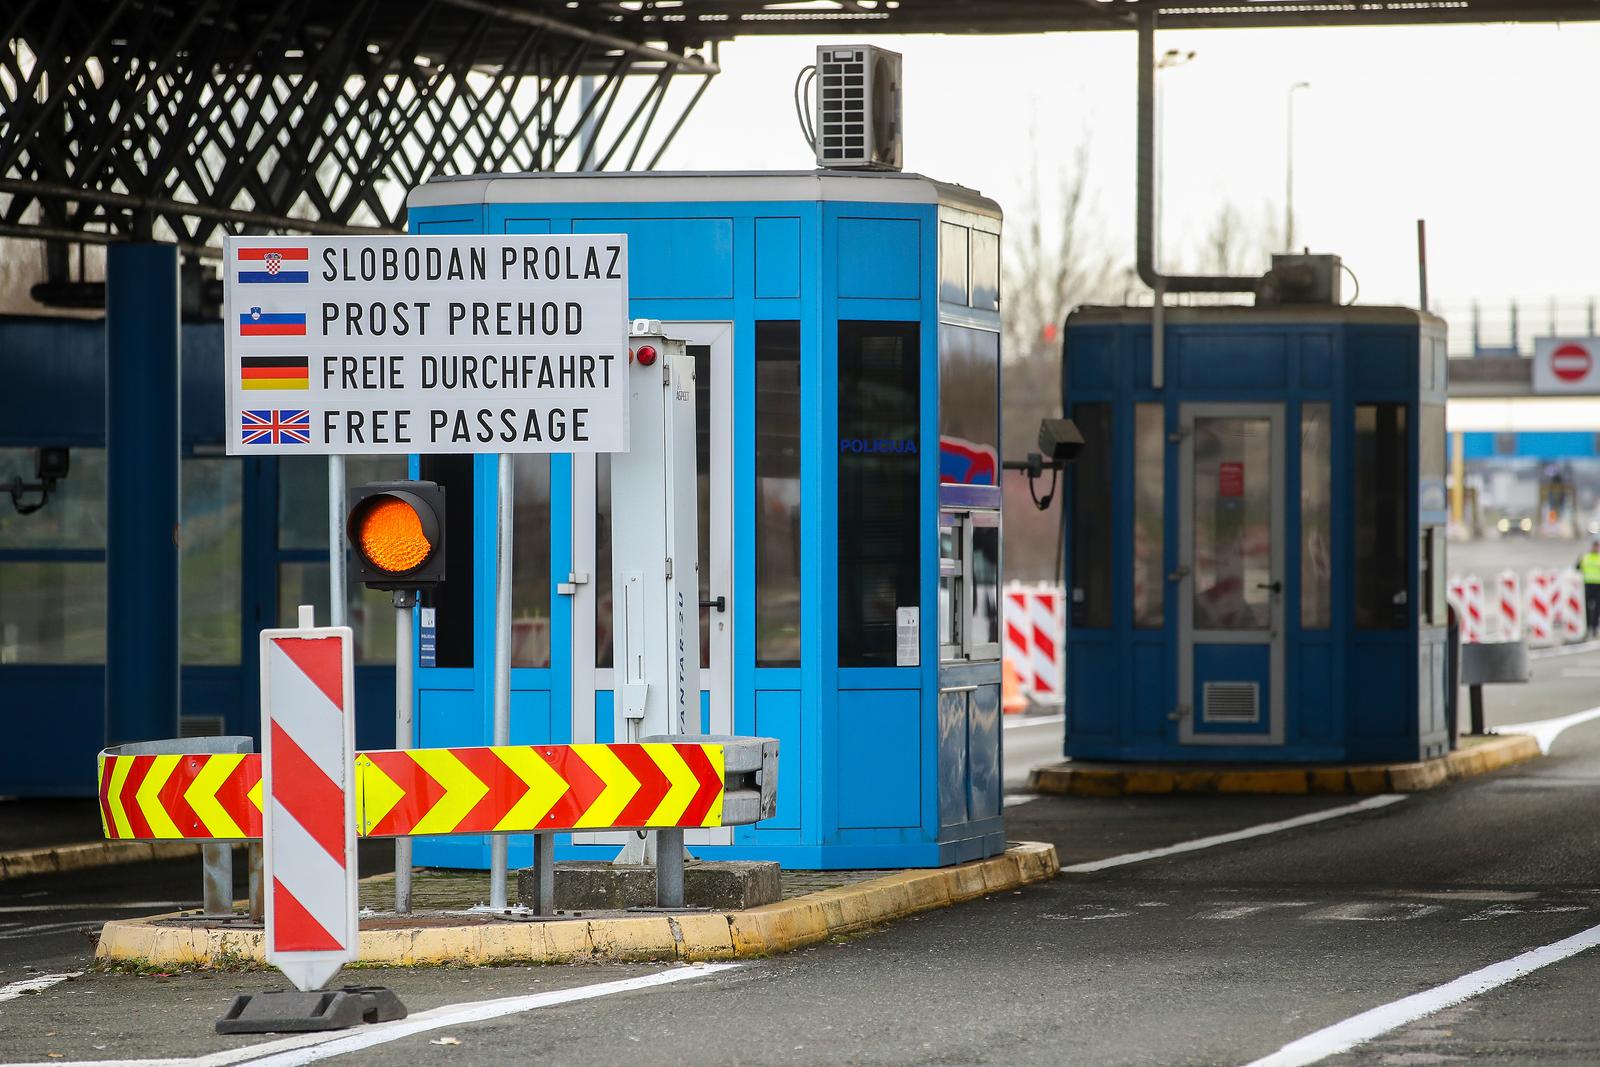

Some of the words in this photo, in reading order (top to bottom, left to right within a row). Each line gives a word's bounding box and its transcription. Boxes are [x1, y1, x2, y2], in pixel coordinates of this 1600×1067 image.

[322, 247, 486, 282] SLOBODAN
[501, 245, 622, 280] PROLAZ
[322, 301, 431, 336] PROST
[449, 301, 582, 336] PREHOD
[323, 355, 405, 390] FREIE
[421, 354, 615, 390] DURCHFAHRT
[324, 410, 412, 444] FREE
[430, 408, 589, 443] PASSAGE
[840, 438, 917, 454] POLICIJA
